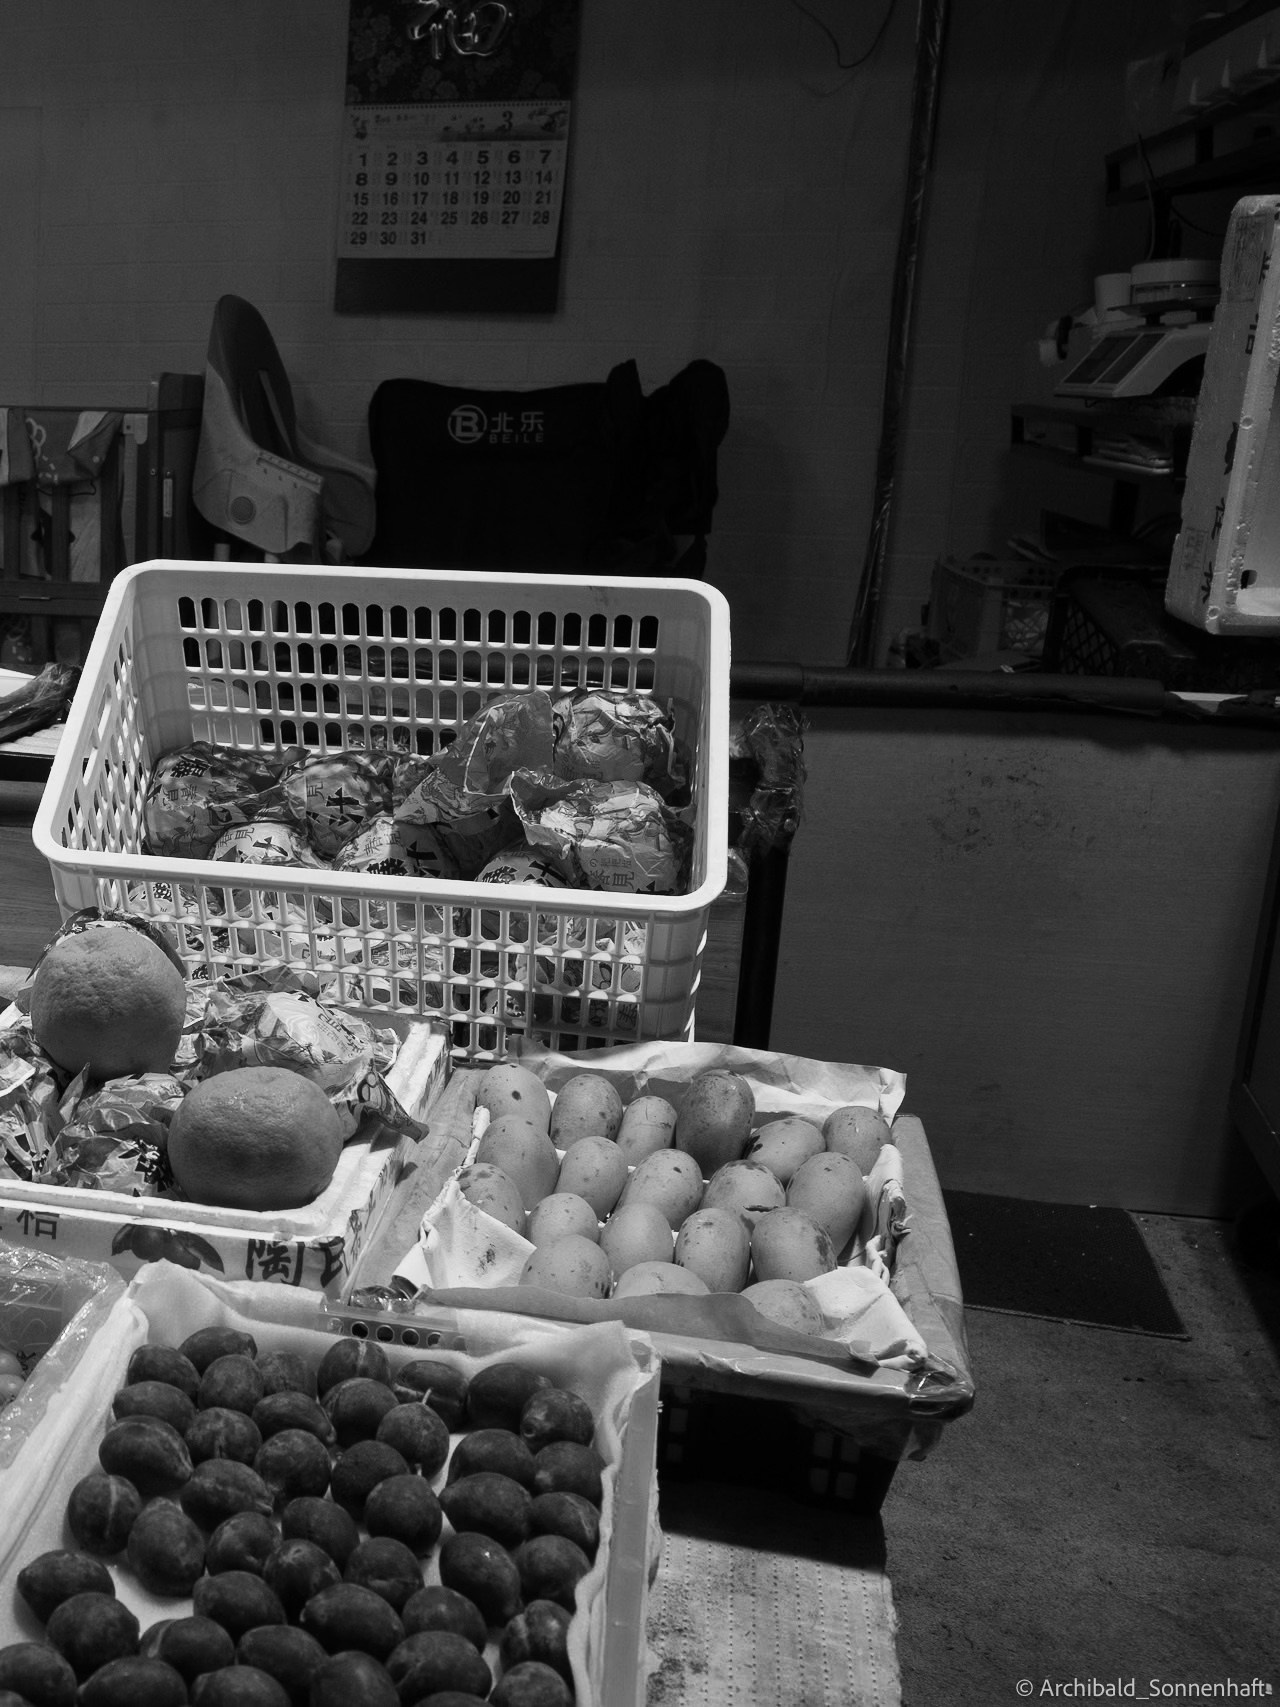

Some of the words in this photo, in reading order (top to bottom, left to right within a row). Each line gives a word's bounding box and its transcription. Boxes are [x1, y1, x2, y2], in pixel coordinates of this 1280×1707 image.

[502, 110, 513, 131] 3
[359, 152, 367, 167] 1
[387, 152, 397, 166] 2
[417, 151, 428, 165] 3
[446, 151, 458, 165] 4
[477, 151, 489, 164] 5
[508, 150, 520, 163] 6
[540, 150, 551, 164] 7
[356, 173, 367, 186] 8
[386, 172, 397, 185] 9
[414, 172, 429, 185] 10
[445, 172, 459, 185] 11
[474, 171, 490, 184] 12
[506, 170, 521, 184] 13
[536, 171, 552, 184] 14
[354, 193, 368, 205] 15
[383, 192, 398, 205] 16
[413, 192, 428, 205] 17
[443, 191, 458, 205] 18
[474, 191, 489, 204] 19
[503, 191, 520, 204] 20
[535, 190, 551, 204] 21
[352, 212, 368, 225] 22
[381, 212, 397, 225] 23
[411, 212, 427, 225] 24
[441, 211, 457, 225] 25
[471, 211, 488, 224] 26
[502, 211, 519, 224] 27
[533, 211, 549, 224] 28
[350, 232, 367, 245] 29
[380, 232, 396, 245] 30
[411, 232, 425, 245] 31
[489, 411, 544, 432] 北乐
[489, 432, 544, 444] BEILE
